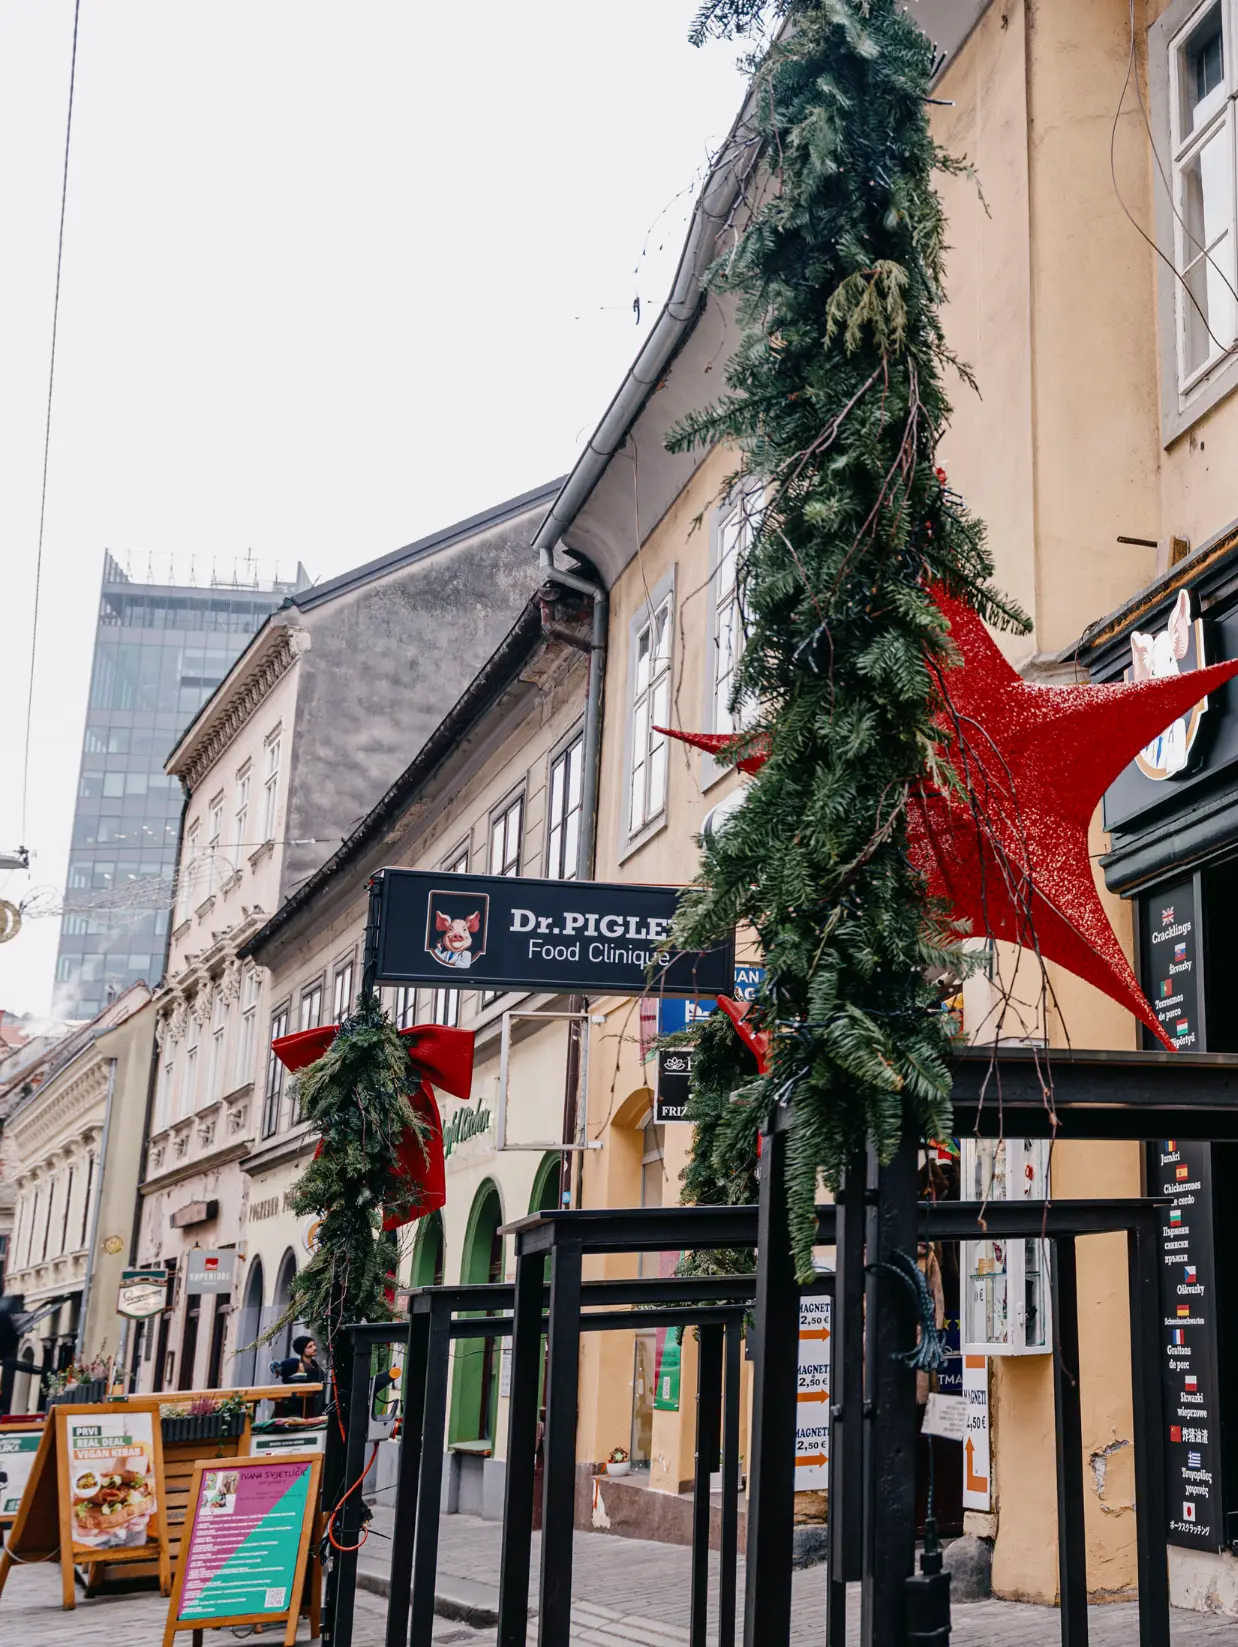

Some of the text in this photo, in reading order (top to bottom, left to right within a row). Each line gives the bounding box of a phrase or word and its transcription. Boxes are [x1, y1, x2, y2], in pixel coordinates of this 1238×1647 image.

[509, 909, 673, 940] Dr.PIGLE
[1152, 922, 1192, 944] Cracklings
[528, 939, 670, 970] Food Clinique
[1155, 994, 1183, 1010] Torresmos
[1158, 1008, 1181, 1021] de porco
[1164, 1182, 1201, 1194] Chicharrones
[1178, 1194, 1195, 1205] cerdo
[800, 1316, 822, 1326] 2,50
[1169, 1359, 1190, 1371] de porc
[799, 1377, 828, 1388] 2,50 €
[982, 1416, 986, 1429] €
[76, 1427, 98, 1436] PRVI
[77, 1438, 125, 1448] REAL DEAL
[797, 1441, 826, 1452] 2,50 €
[77, 1447, 140, 1459] VEGAN KEBAB
[241, 1472, 262, 1480] IVANA
